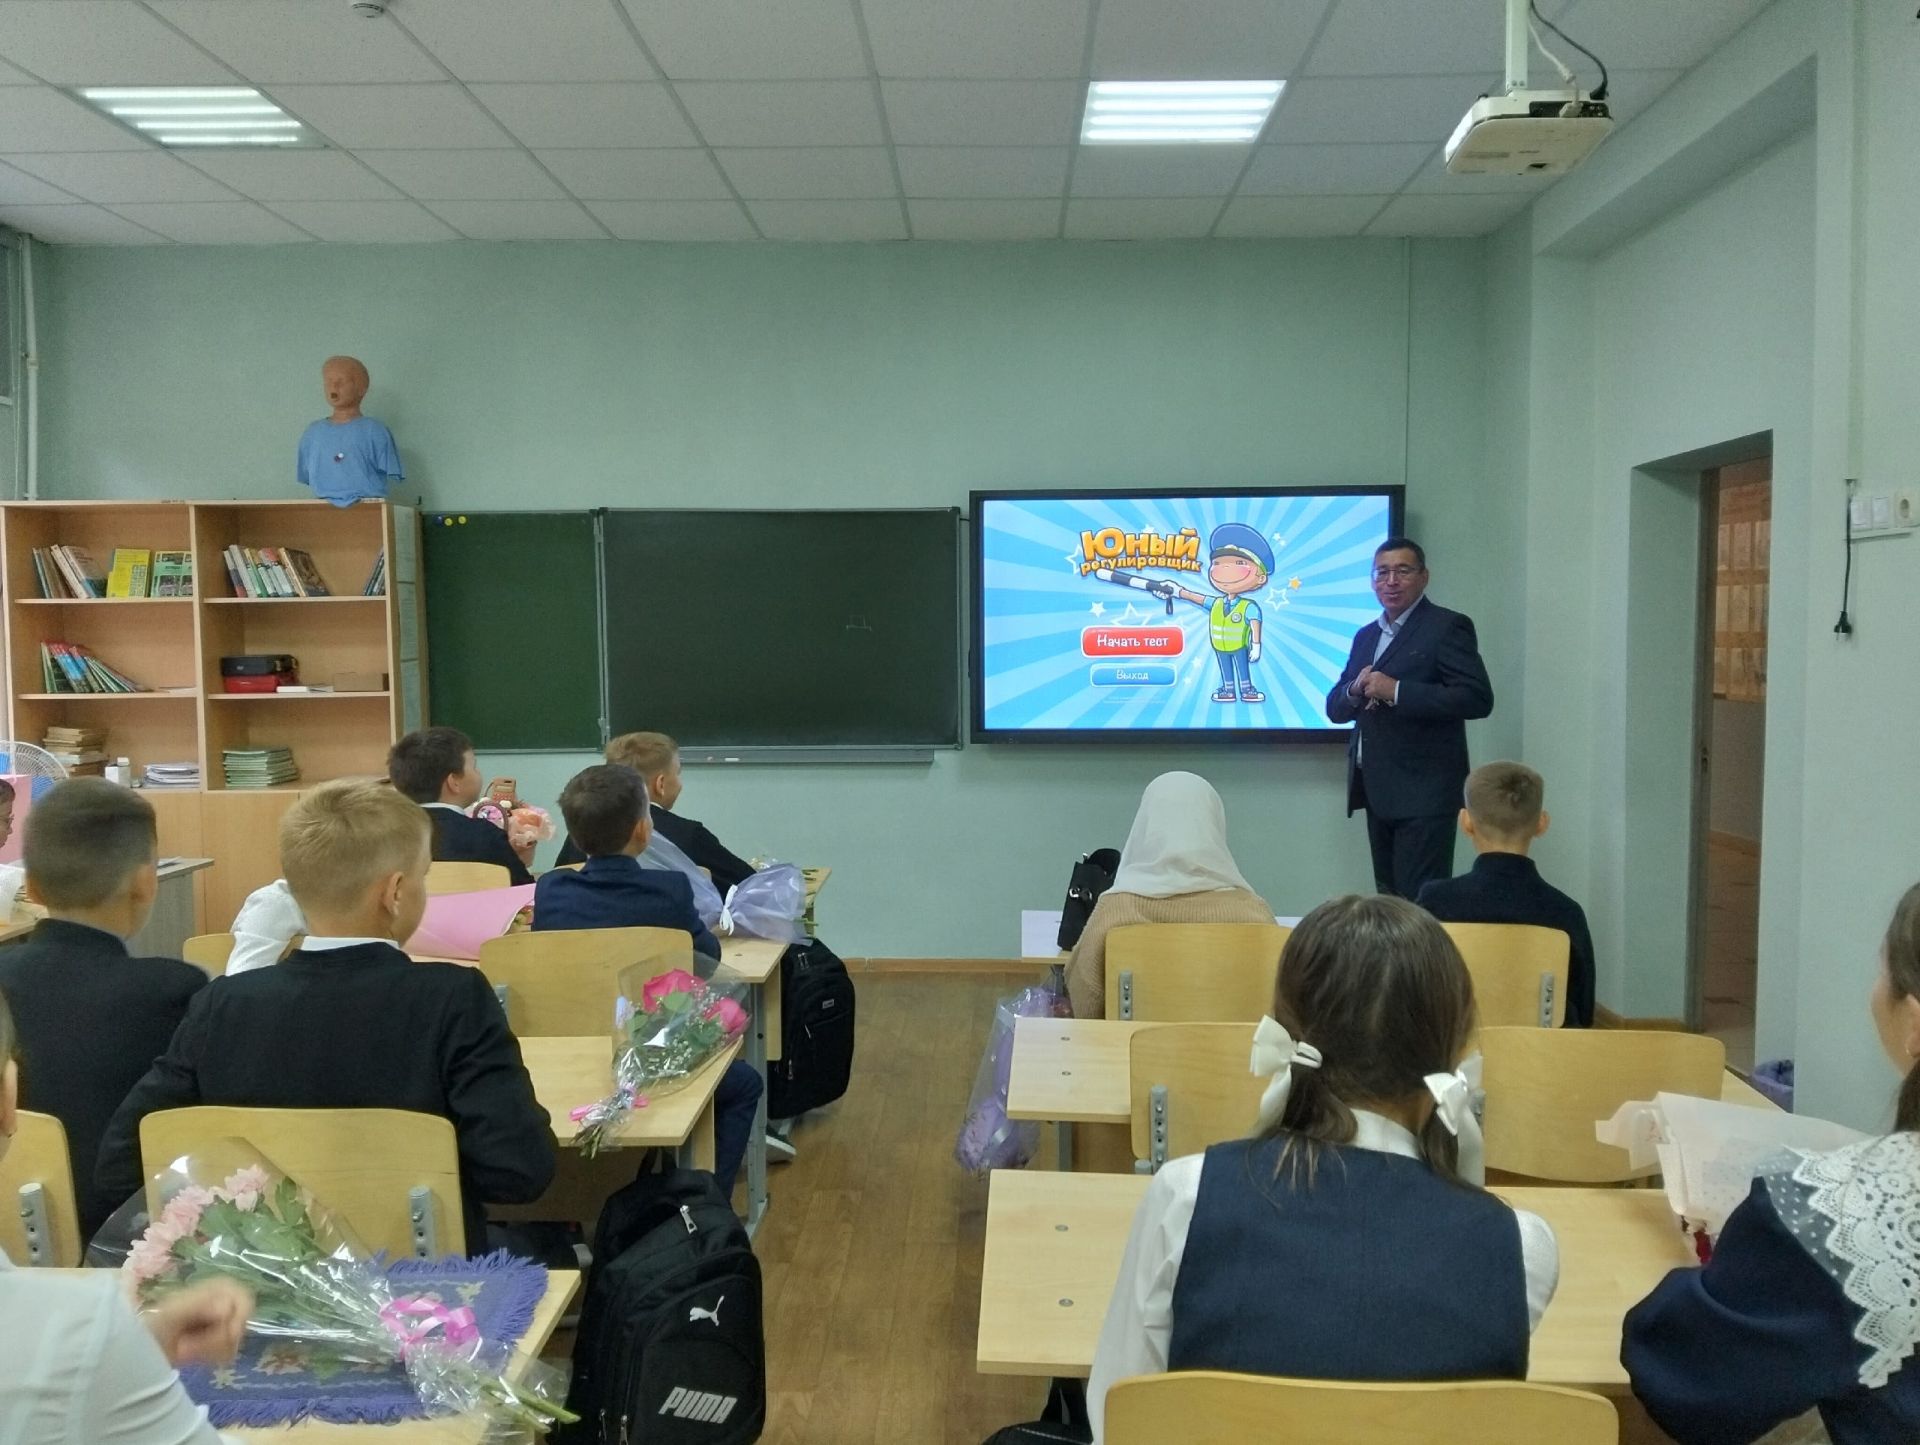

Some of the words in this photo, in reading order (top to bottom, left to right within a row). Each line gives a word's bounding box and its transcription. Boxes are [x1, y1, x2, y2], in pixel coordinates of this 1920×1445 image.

[1080, 527, 1201, 561] Юный
[1080, 557, 1202, 576] регулировщик
[1097, 634, 1141, 647] Начать
[1143, 637, 1168, 647] тест
[1116, 669, 1149, 680] Выход
[659, 1386, 738, 1424] PUMA
